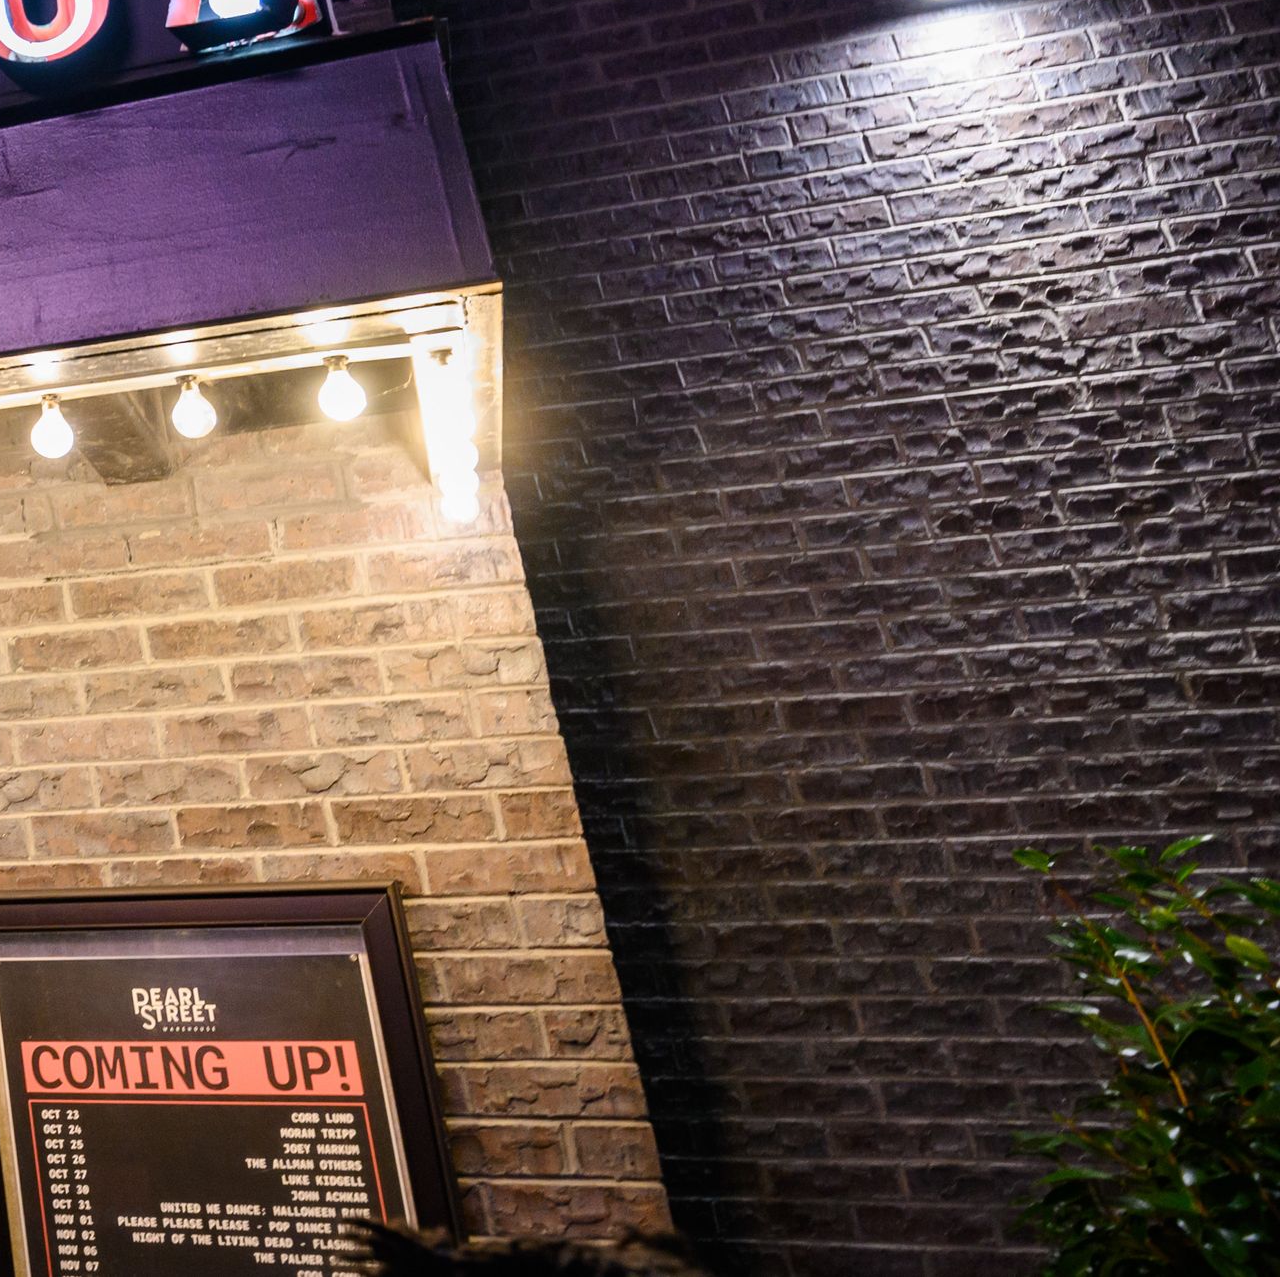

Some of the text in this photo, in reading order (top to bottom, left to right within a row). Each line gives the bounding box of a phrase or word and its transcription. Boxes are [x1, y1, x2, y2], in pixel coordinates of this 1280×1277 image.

[132, 987, 206, 1014] PEARL
[140, 1004, 216, 1030] STREET
[31, 1044, 352, 1091] COMING UP!
[41, 1109, 80, 1120] OCT 23
[291, 1112, 354, 1124] CORB LUND
[43, 1124, 82, 1135] OCT 24
[320, 1128, 357, 1140] TRIPP
[45, 1138, 84, 1150] OCT 25
[283, 1143, 311, 1155] JOEY
[47, 1153, 86, 1165] OCT 26
[245, 1157, 363, 1172] THE ALLMAN OTHERS
[48, 1168, 87, 1180] OCT 27
[281, 1174, 311, 1186] LUKE
[50, 1183, 90, 1195] OCT 30
[291, 1190, 320, 1202] JOHN
[52, 1198, 92, 1210] OCT 31
[160, 1202, 201, 1214] UNITED
[206, 1203, 221, 1215] WE
[272, 1205, 337, 1218] HALLOWEEN
[54, 1214, 94, 1225] NOV 01
[117, 1216, 158, 1228] PLEASE
[162, 1217, 204, 1230] PLEASE
[208, 1219, 250, 1231] PLEASE
[268, 1221, 290, 1232] POP
[295, 1222, 332, 1234] DANCE
[56, 1229, 96, 1241] NOV 02
[132, 1232, 166, 1243] NIGHT
[171, 1233, 185, 1244] OF
[190, 1234, 213, 1245] THE
[217, 1235, 260, 1247] LIVING
[264, 1236, 293, 1248] DEAD
[58, 1244, 98, 1256] NOV 06
[253, 1252, 275, 1264] THE
[280, 1253, 324, 1266] PALMER
[60, 1260, 99, 1271] NOV 07
